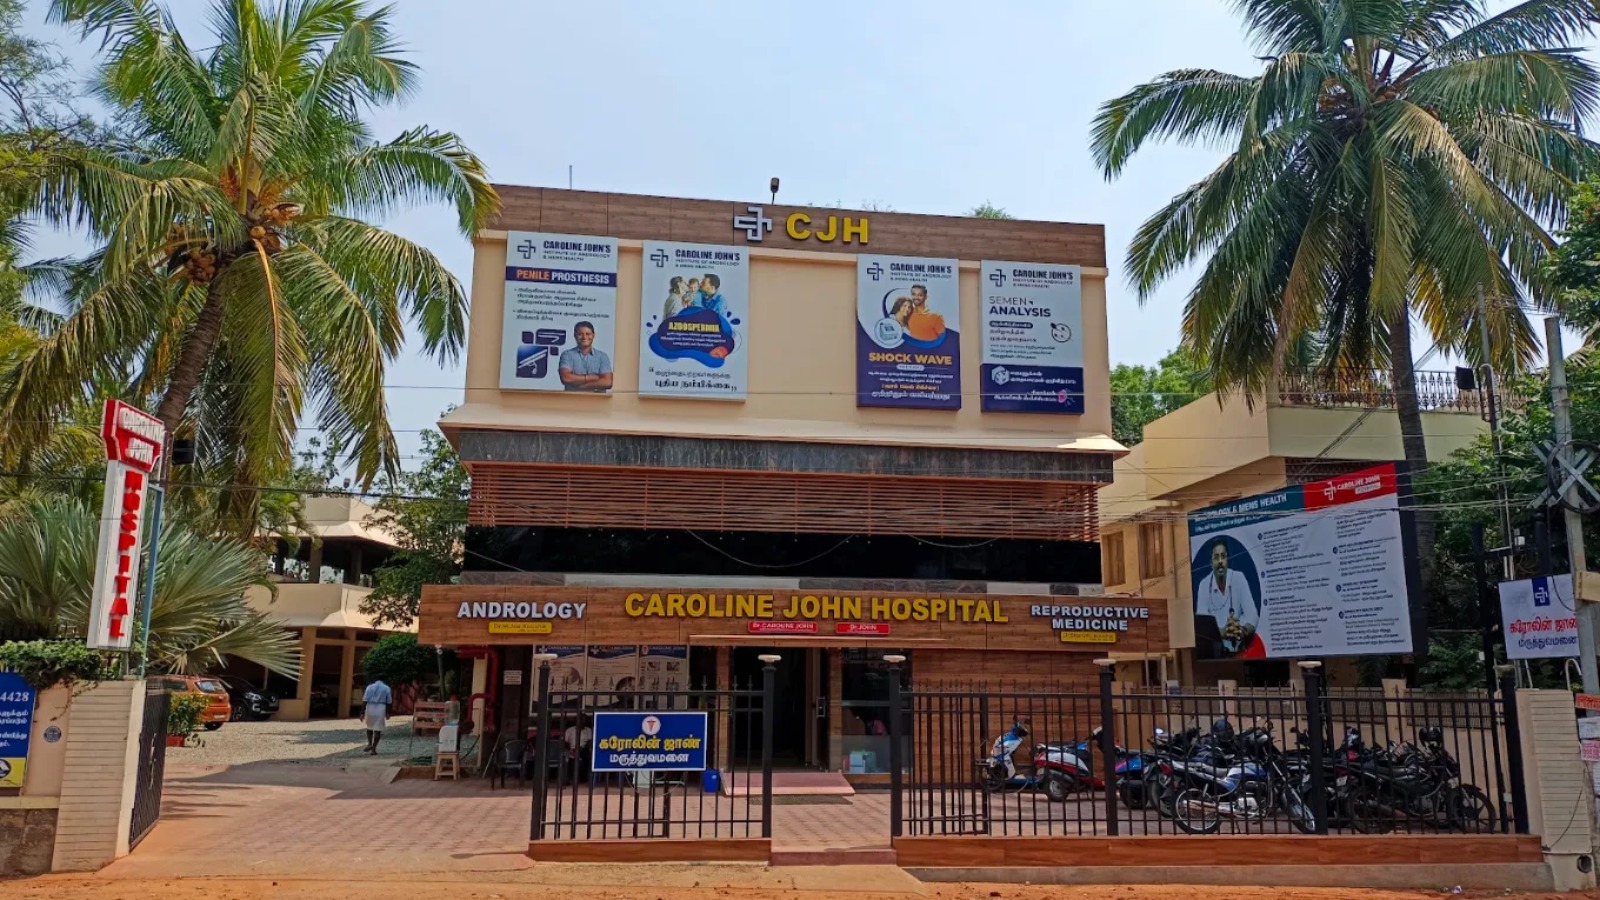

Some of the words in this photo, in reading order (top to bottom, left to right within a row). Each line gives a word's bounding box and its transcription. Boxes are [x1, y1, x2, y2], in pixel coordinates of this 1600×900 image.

[787, 212, 868, 243] CJH
[543, 240, 583, 251] CAROLINE
[584, 243, 611, 253] JOHN'S
[676, 249, 712, 260] CAROLINE
[714, 251, 740, 261] JOHN'S
[890, 263, 925, 273] CAROLINE
[927, 265, 952, 274] JOHN'S
[1013, 269, 1047, 279] CAROLINE
[1049, 271, 1073, 281] JOHN'S
[516, 269, 550, 281] PENILE
[551, 271, 610, 284] PROSTHESIS
[989, 296, 1027, 306] SEMEN
[989, 306, 1051, 318] ANALYSIS
[668, 322, 720, 333] AZOOSPERMIA
[869, 352, 911, 364] SHOCK
[915, 354, 952, 366] WAVE
[1239, 500, 1258, 512] MENS
[1260, 493, 1287, 508] HEALTH
[109, 470, 143, 639] HOSPITAL
[457, 602, 586, 619] ANDROLOGY
[624, 593, 775, 618] CAROLINE
[783, 595, 862, 620] JOHN
[870, 597, 1009, 623] HOSPITAL
[1031, 605, 1149, 619] REPRODUCTIVE
[1052, 618, 1128, 631] MEDICINE
[1510, 616, 1552, 635] கரோலின்
[1519, 636, 1577, 649] மருத்துவமனை
[599, 733, 661, 752] கரோலின்
[609, 750, 689, 767] மருத்துவமனை
